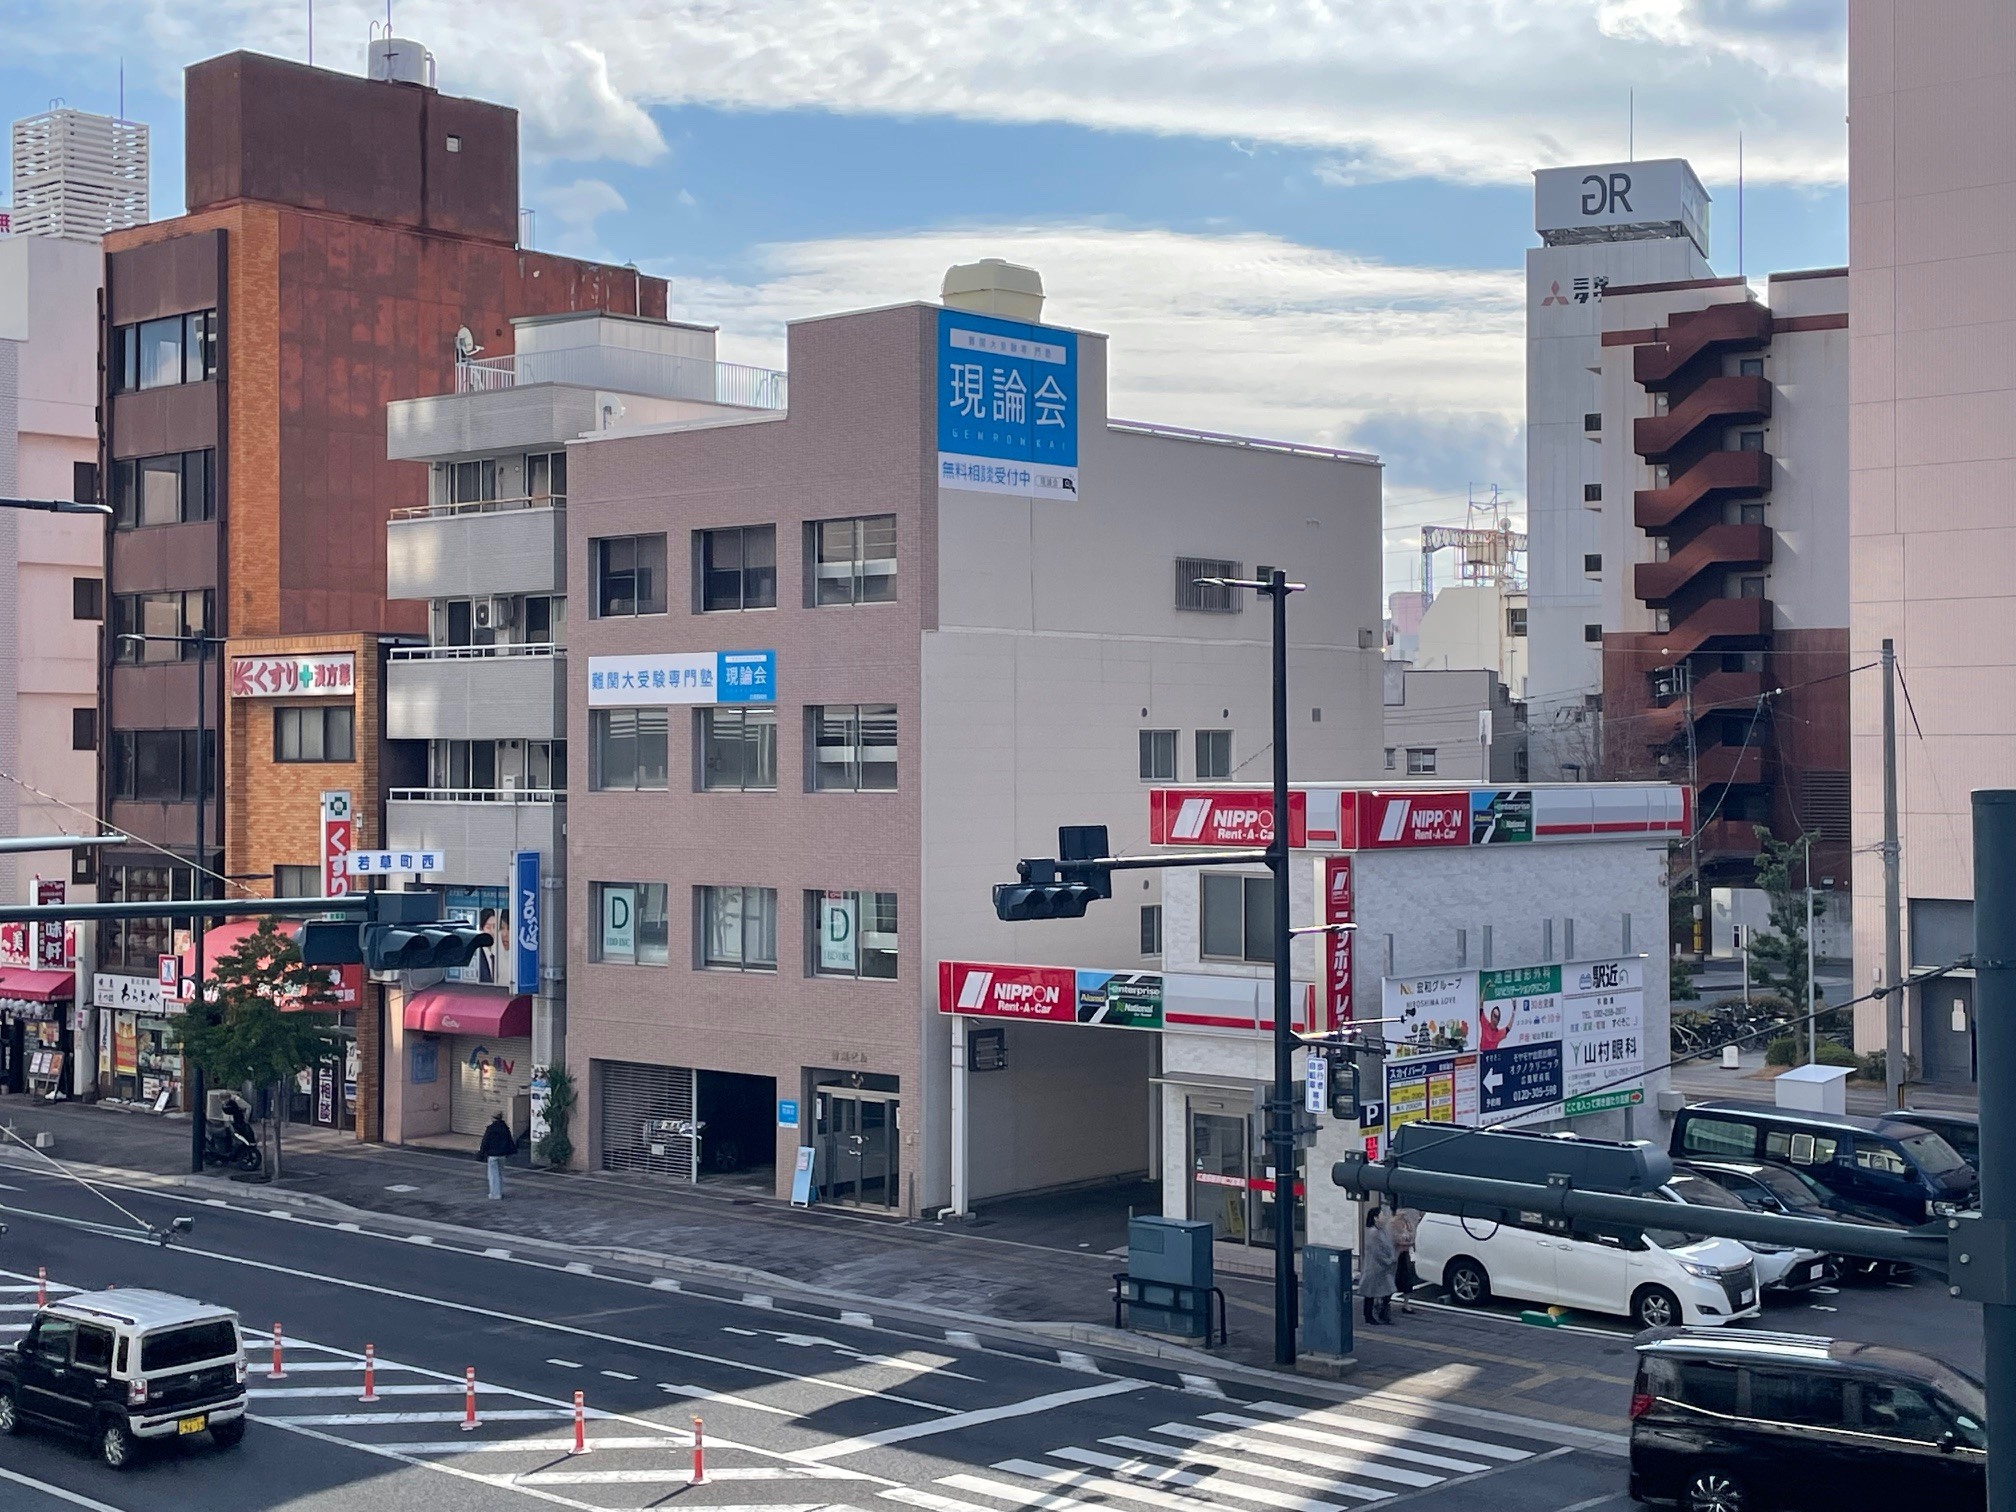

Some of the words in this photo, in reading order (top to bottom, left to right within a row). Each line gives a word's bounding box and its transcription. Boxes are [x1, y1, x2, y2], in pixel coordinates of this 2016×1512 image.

[949, 363, 1067, 429] 現論会
[952, 428, 1066, 451] GENRONKAI
[942, 461, 1030, 487] 無料相談受付中
[254, 661, 298, 692] くすり
[591, 668, 714, 690] 難関大受験専門塾
[726, 665, 767, 686] 現論会
[1212, 809, 1274, 828] NIPPO
[1411, 809, 1463, 828] NIPPON
[1217, 828, 1275, 840] Rent-A-Ca
[329, 827, 347, 897] くすり
[357, 854, 434, 870] 若草町西
[612, 896, 629, 929] D
[830, 907, 849, 942] D
[1592, 963, 1618, 988] 駅近
[994, 982, 1060, 1004] NIPPON
[1110, 985, 1160, 995] enterprise
[1124, 1003, 1154, 1013] National
[1584, 1036, 1637, 1064] 山村眼科
[1389, 1064, 1428, 1080] スカイパーク
[1509, 1058, 1559, 1076] オクノクリニック
[1366, 1104, 1379, 1126] P
